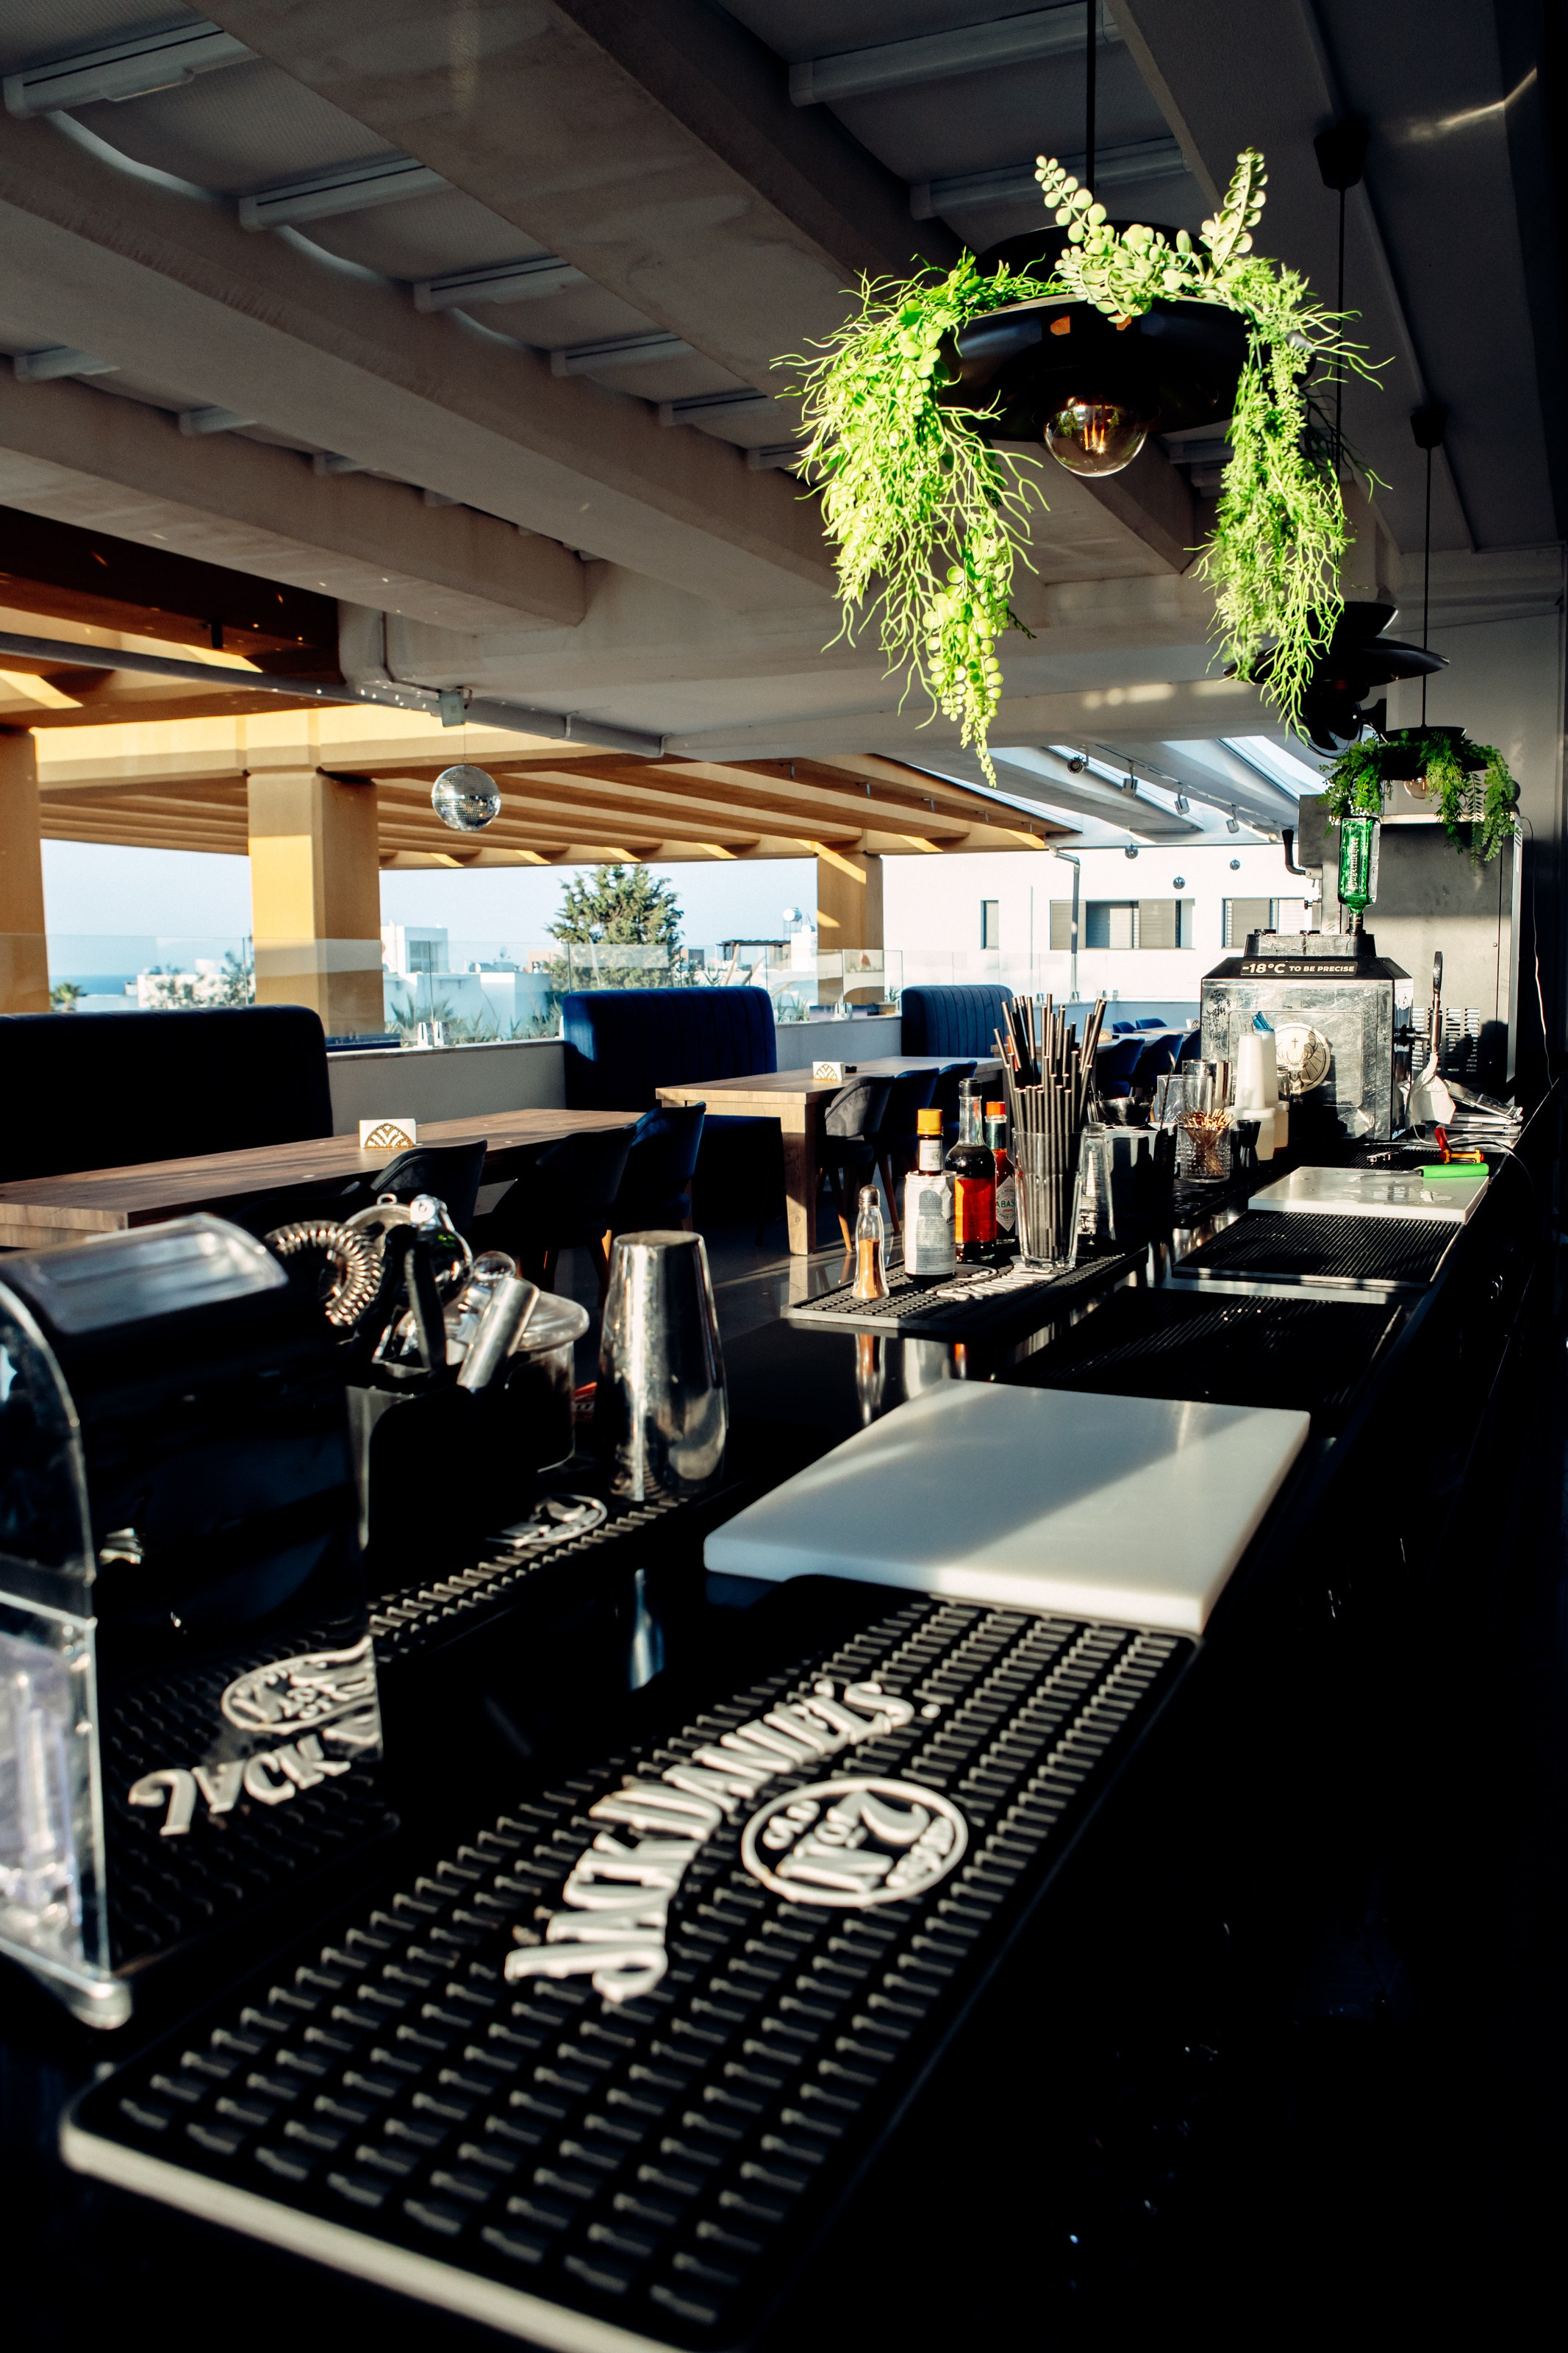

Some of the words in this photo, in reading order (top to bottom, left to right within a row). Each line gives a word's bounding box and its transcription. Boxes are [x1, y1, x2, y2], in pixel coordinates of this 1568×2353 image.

[1242, 963, 1286, 974] -18°C
[996, 1199, 1015, 1208] ABAS
[504, 1830, 702, 2004] JACK
